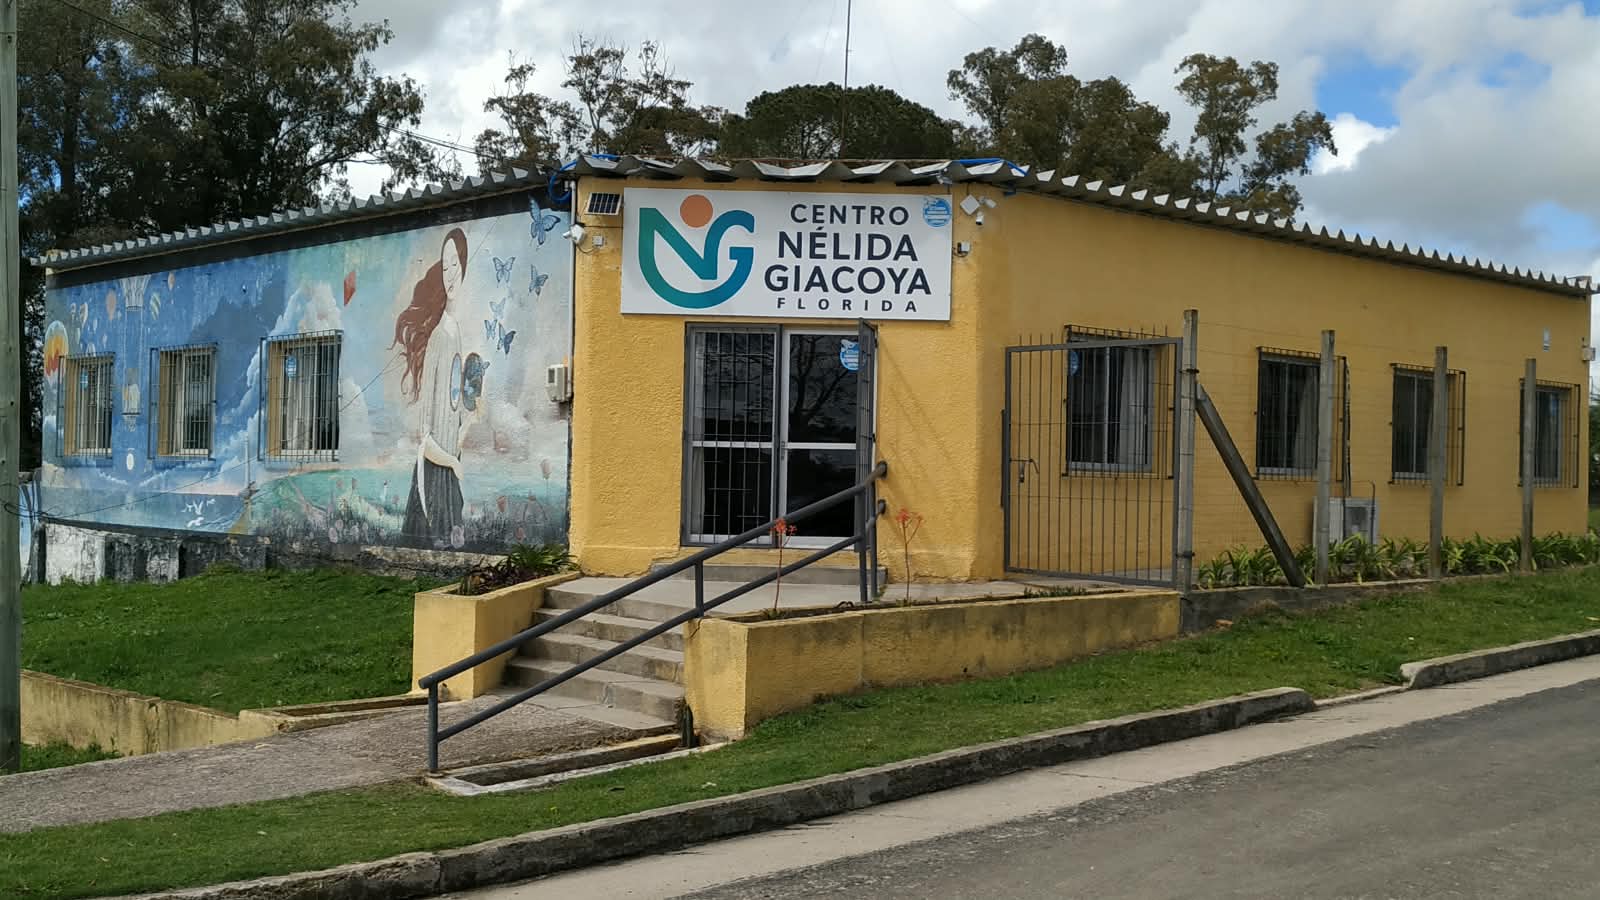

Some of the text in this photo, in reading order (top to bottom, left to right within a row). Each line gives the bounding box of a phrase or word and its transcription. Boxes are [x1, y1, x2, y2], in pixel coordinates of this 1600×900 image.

[790, 203, 910, 227] CENTRO
[778, 226, 919, 262] NÉLIDA
[764, 264, 932, 295] GIACOYA
[777, 297, 917, 313] FLORIDA
